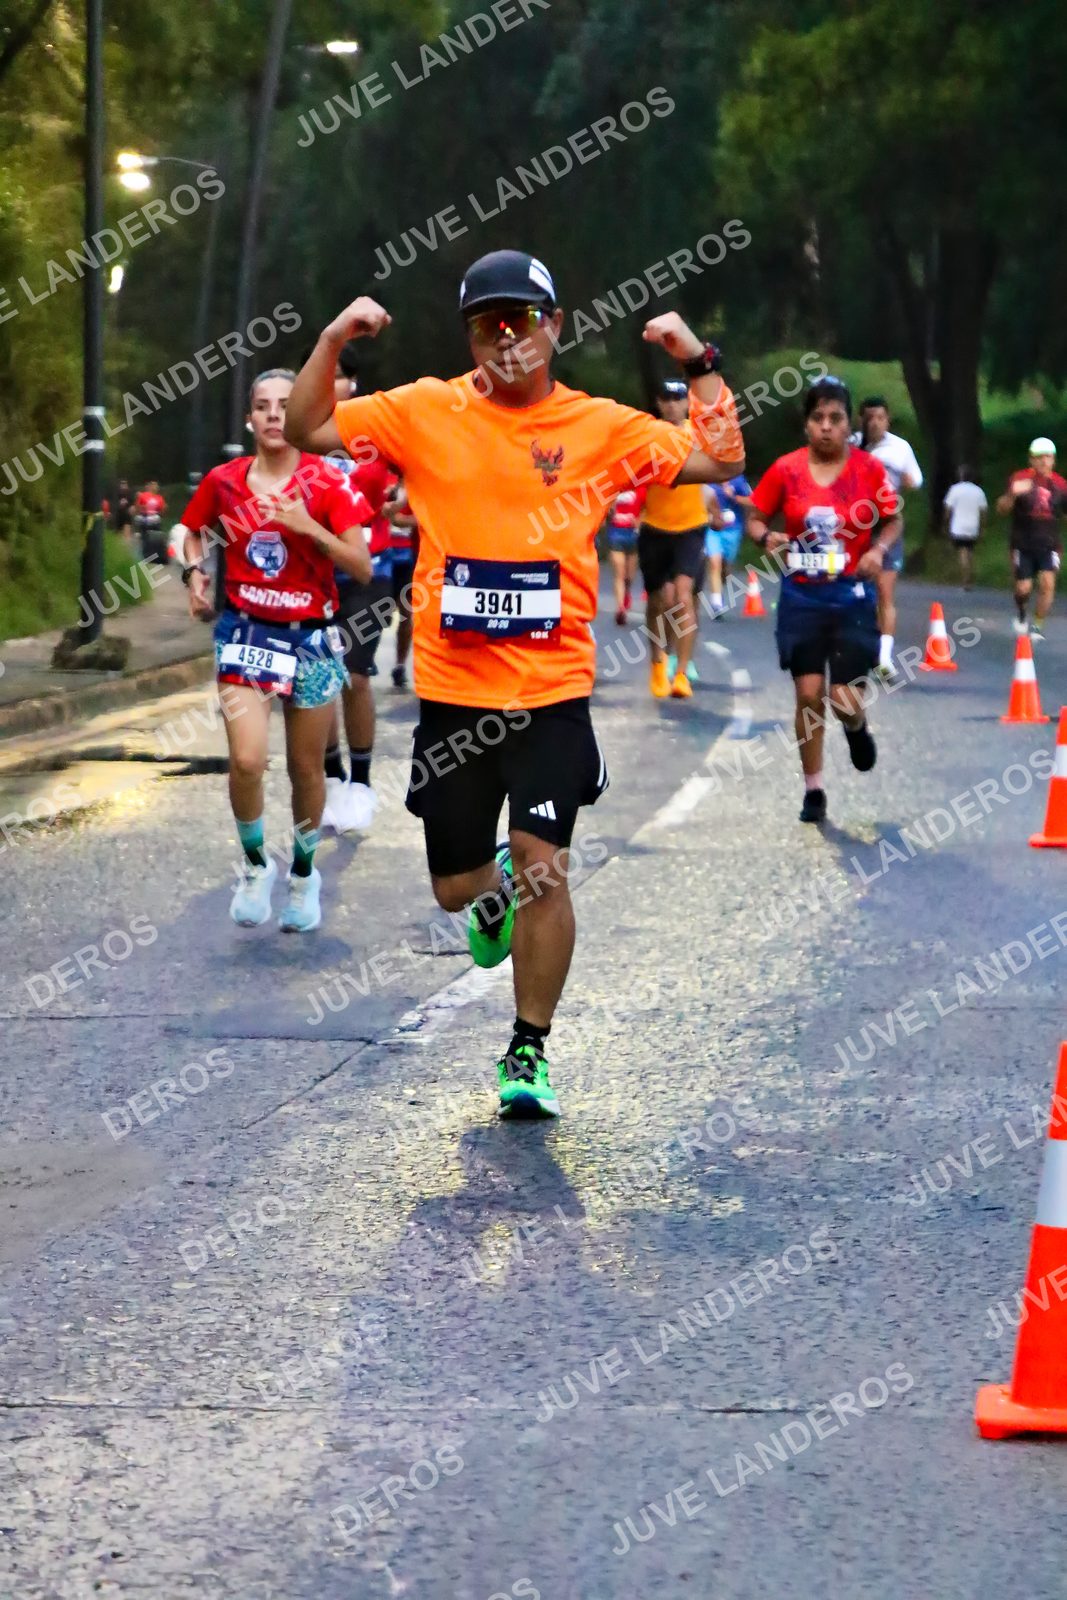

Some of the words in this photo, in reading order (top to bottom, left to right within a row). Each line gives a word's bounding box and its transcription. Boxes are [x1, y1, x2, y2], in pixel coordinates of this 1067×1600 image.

[239, 584, 312, 608] SANTIAGO
[474, 591, 522, 616] 3941
[238, 646, 274, 668] 4528
